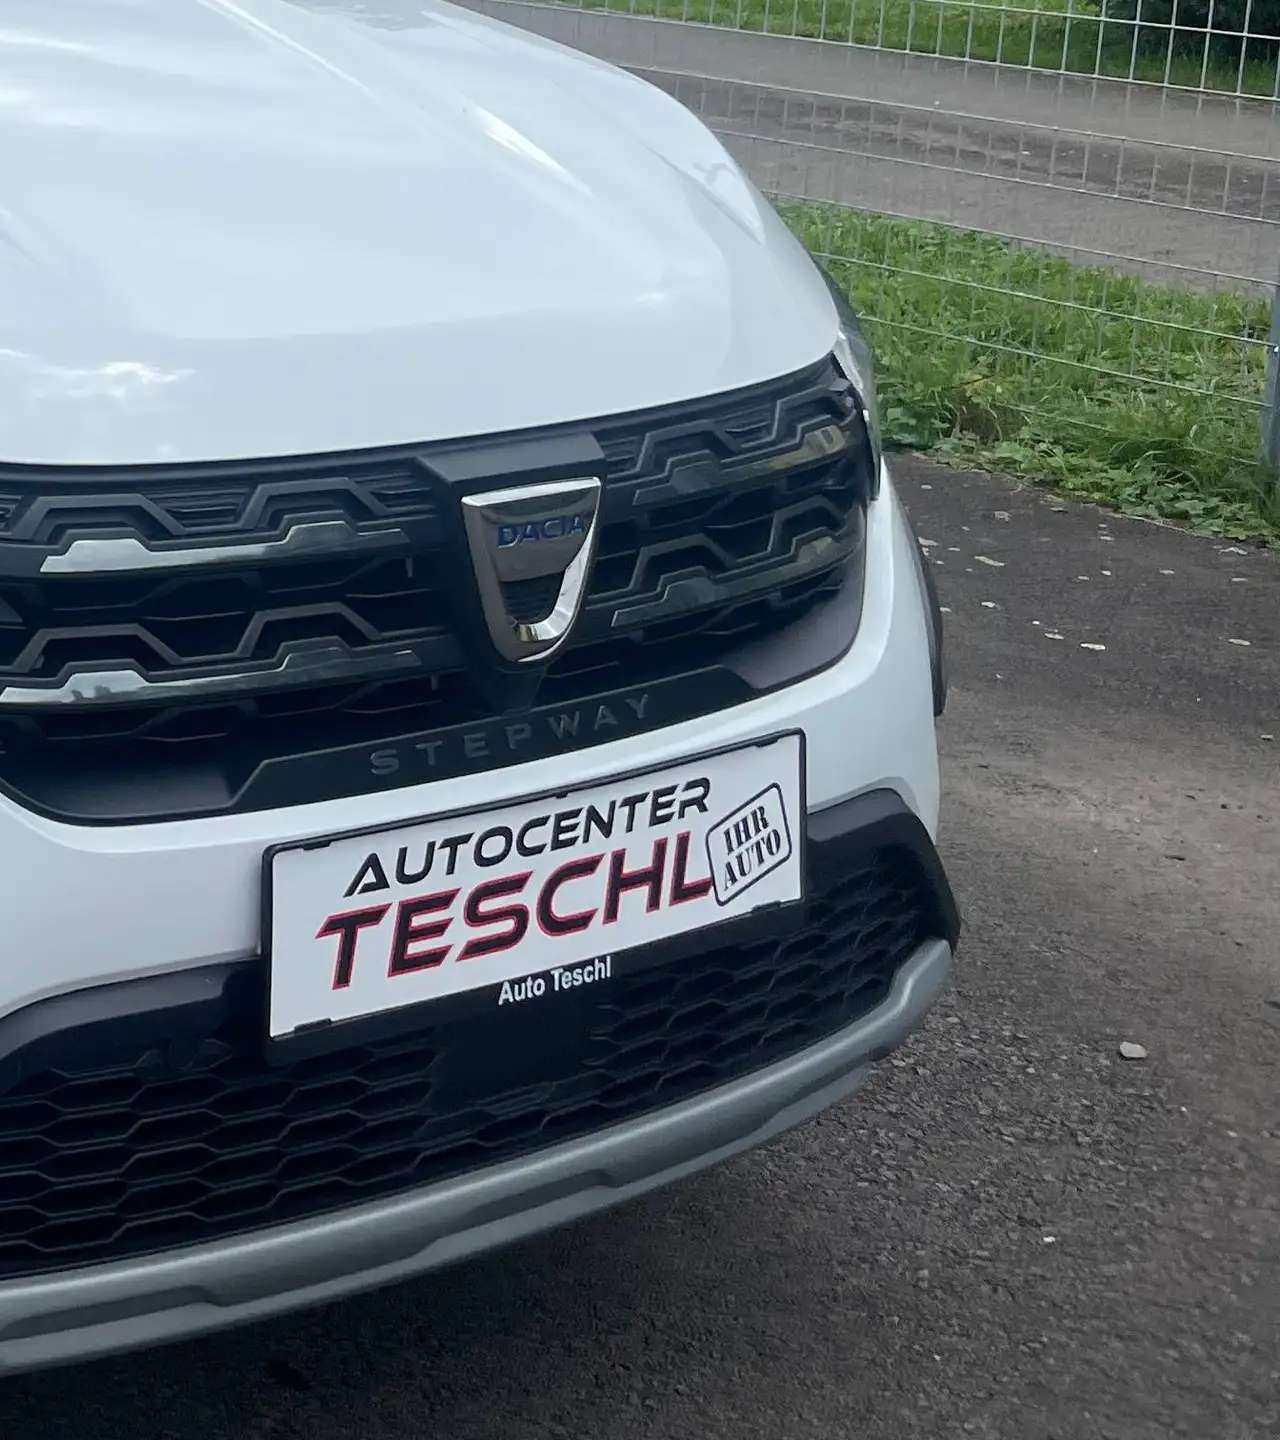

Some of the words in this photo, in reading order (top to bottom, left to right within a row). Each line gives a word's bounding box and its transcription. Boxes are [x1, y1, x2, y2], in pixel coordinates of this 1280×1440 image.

[497, 515, 585, 549] DACIA
[369, 694, 648, 776] STEPWAY
[343, 776, 711, 898] AUTOCENTER
[723, 805, 769, 856] IHR
[723, 828, 781, 892] AUTO
[316, 830, 715, 991] TESCHL
[498, 975, 546, 1006] Auto
[550, 955, 611, 992] Teschl
